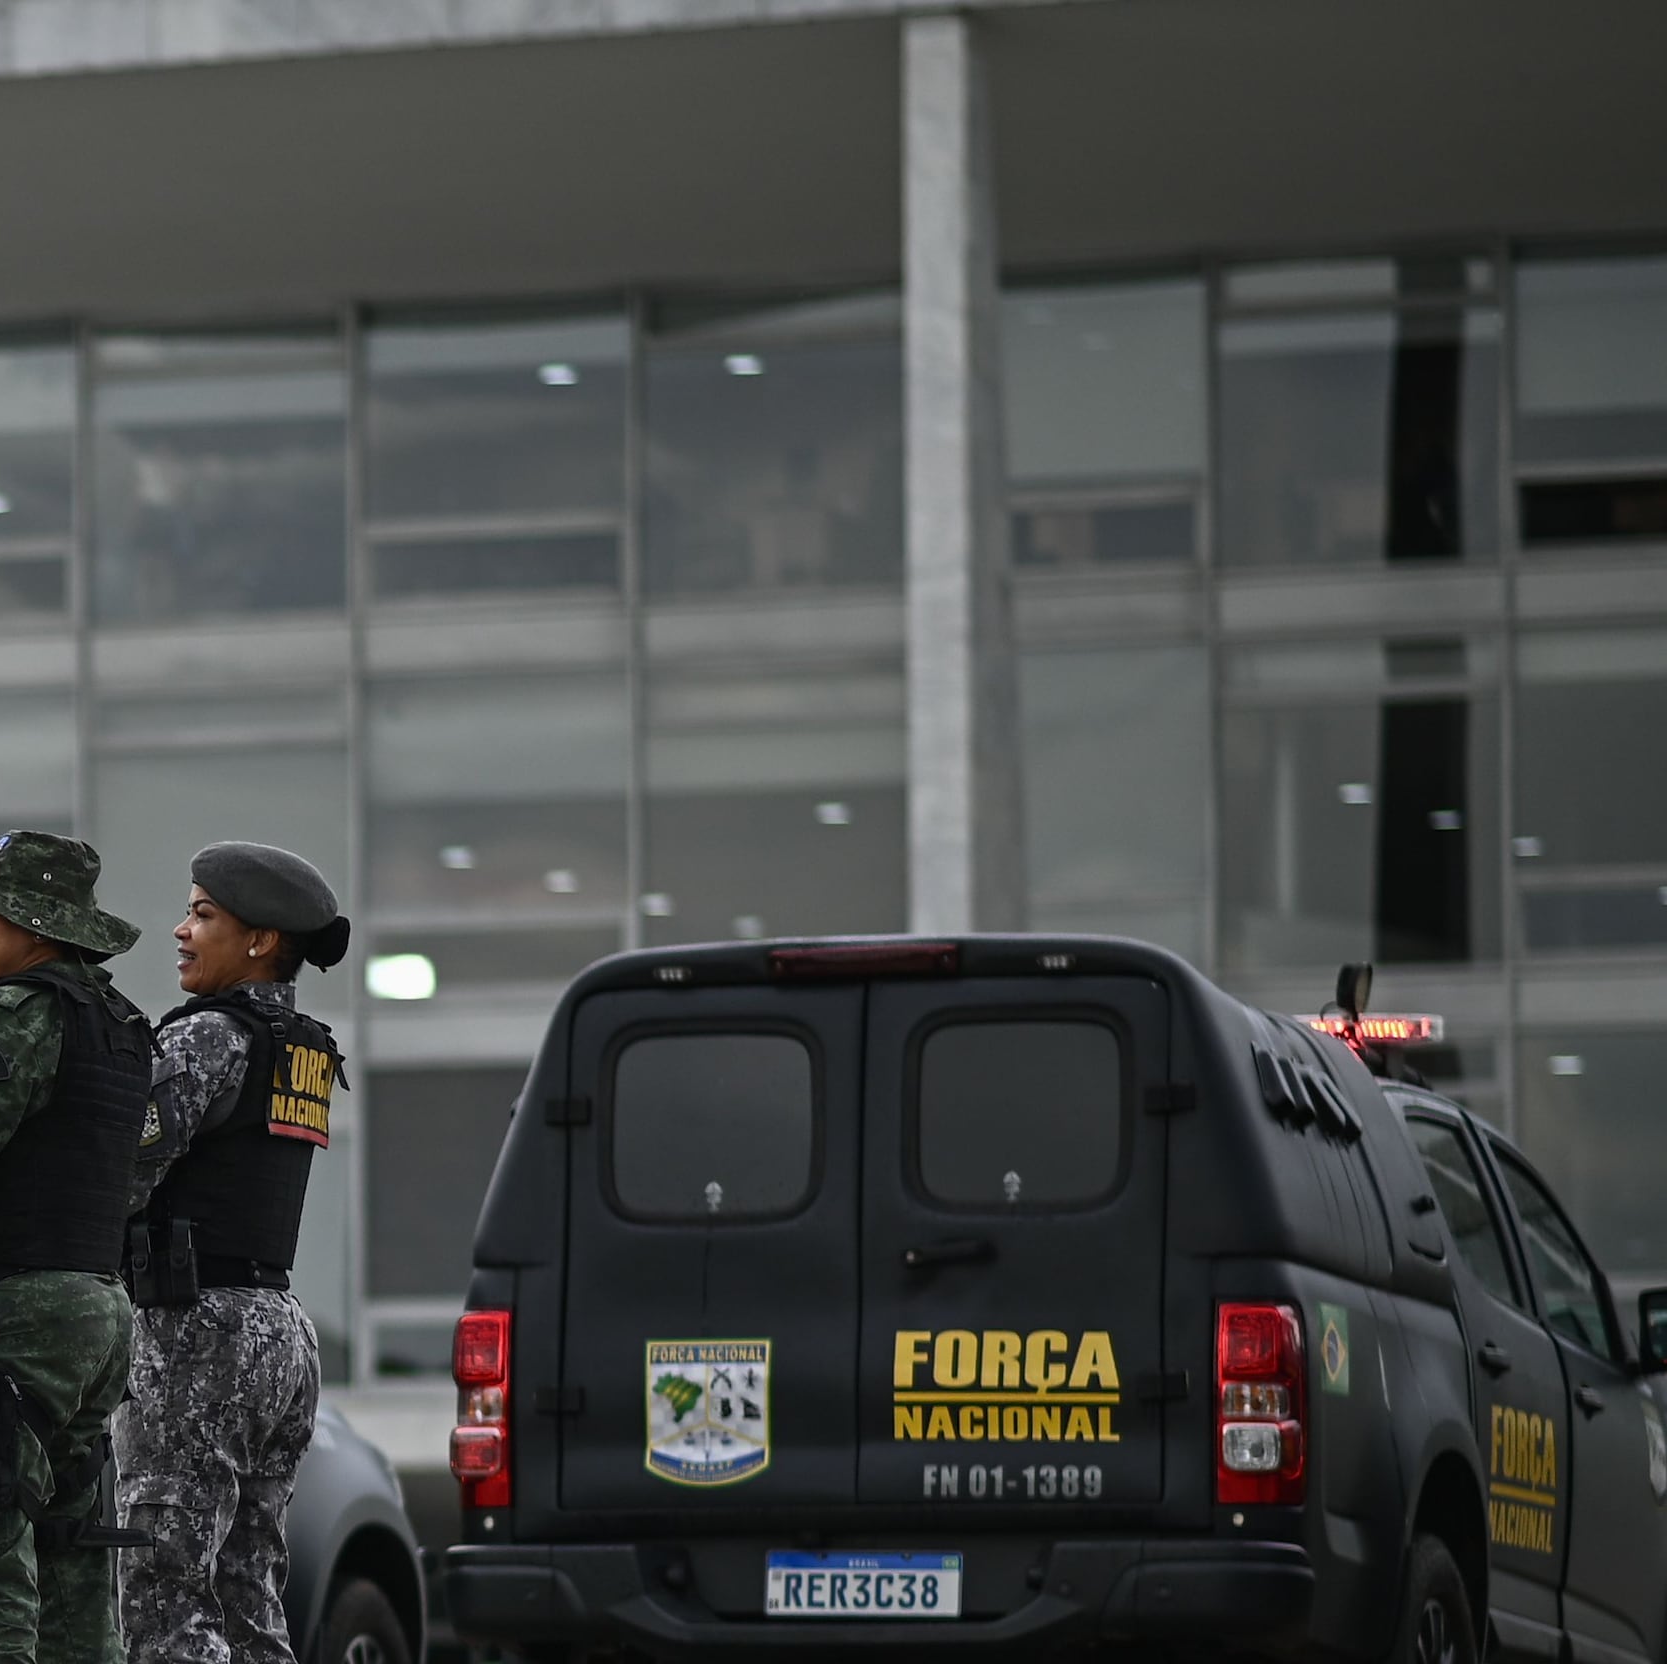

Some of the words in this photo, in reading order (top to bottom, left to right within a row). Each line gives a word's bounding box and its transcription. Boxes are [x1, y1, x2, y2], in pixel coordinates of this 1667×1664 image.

[699, 1345, 763, 1360] NACIONAL
[893, 1329, 1120, 1394] FORÇA
[893, 1406, 1120, 1442] NACIONAL
[1490, 1404, 1557, 1491] FORÇA
[923, 1465, 959, 1497] FN
[969, 1464, 1102, 1498] 01-1389
[1488, 1499, 1553, 1553] NACIONAL
[848, 1558, 880, 1568] BRASIL
[784, 1573, 939, 1609] RER3C38
